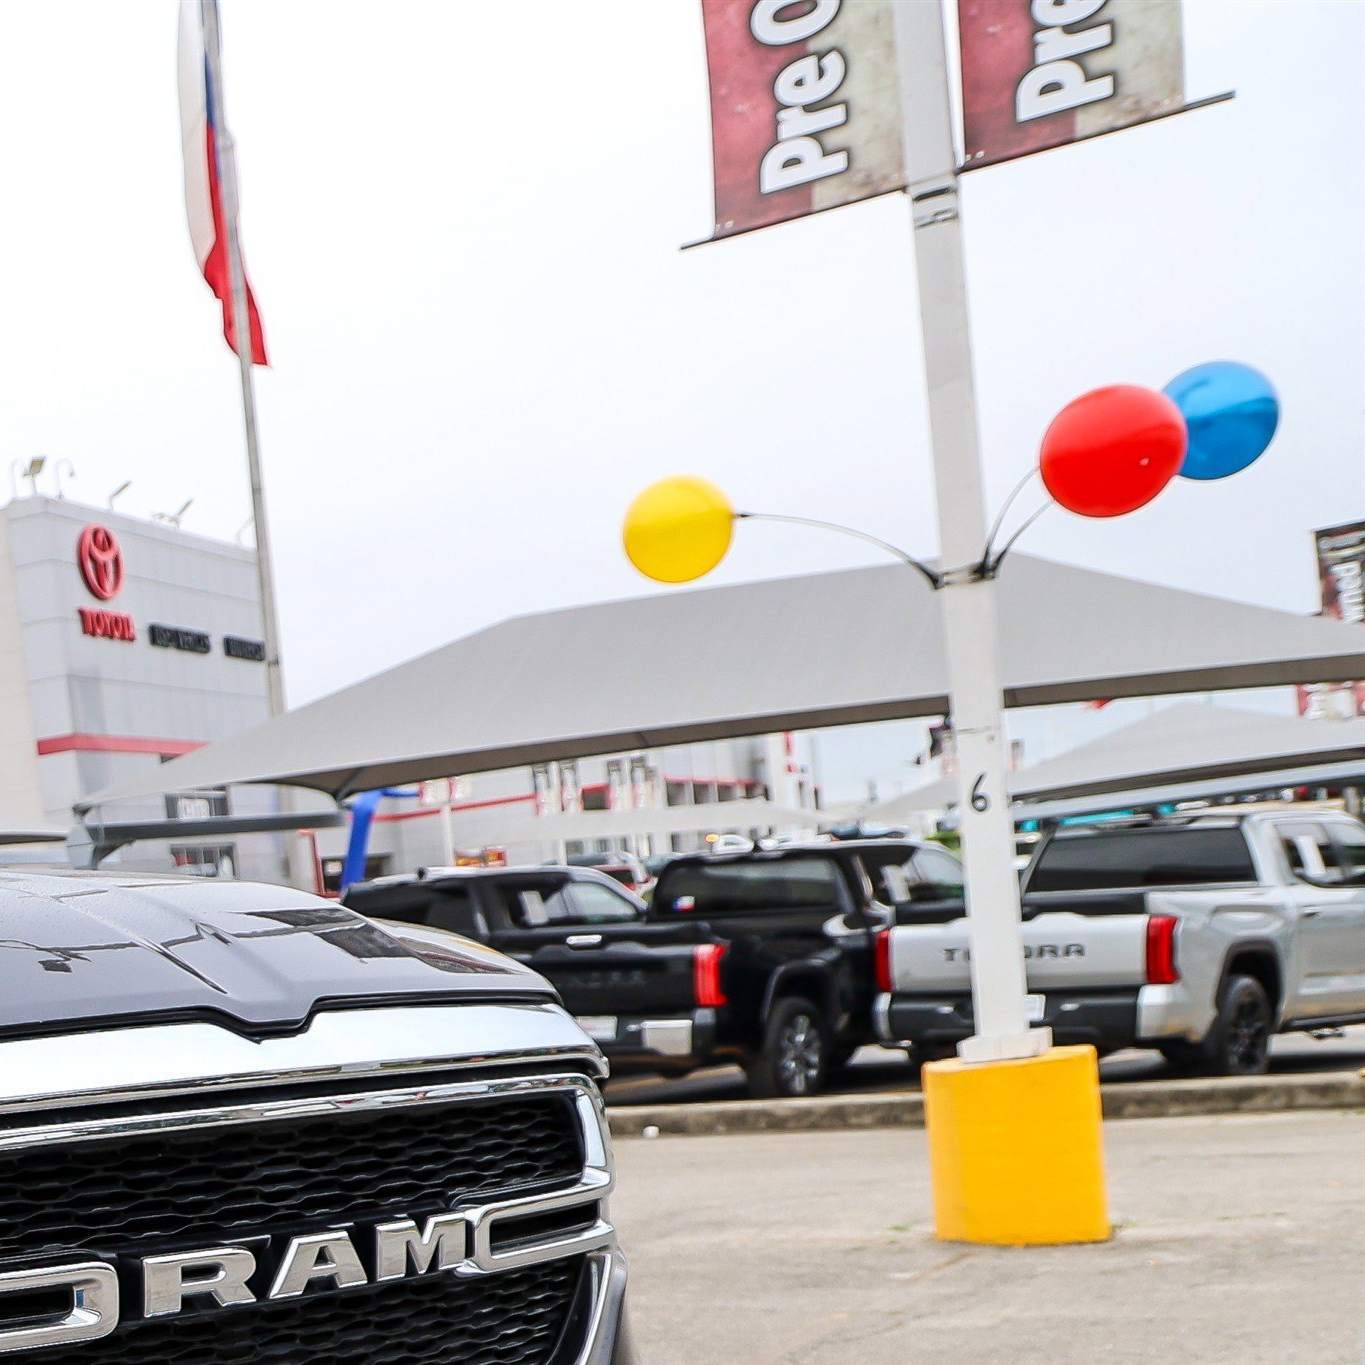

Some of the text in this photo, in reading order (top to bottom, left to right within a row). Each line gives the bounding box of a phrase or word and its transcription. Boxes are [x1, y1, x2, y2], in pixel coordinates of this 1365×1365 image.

[760, 50, 848, 194] Pre
[971, 772, 988, 812] 6
[143, 1211, 468, 1318] RAM
